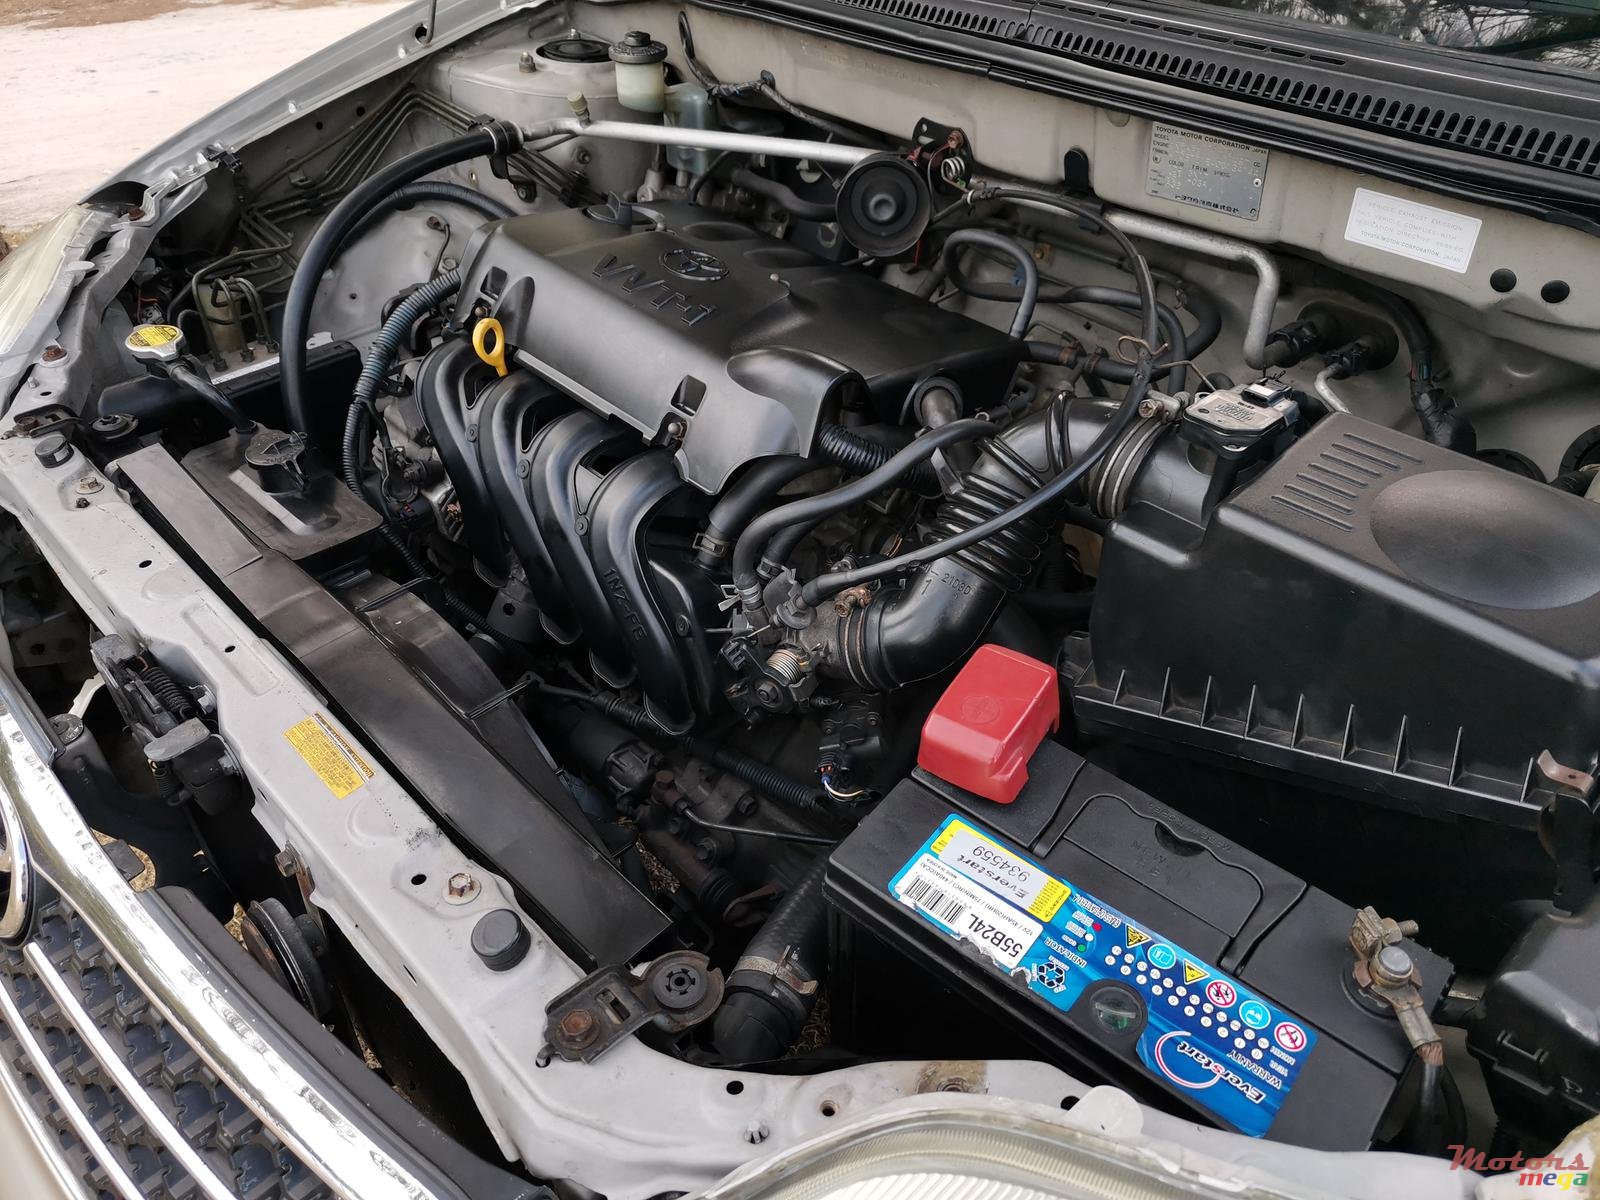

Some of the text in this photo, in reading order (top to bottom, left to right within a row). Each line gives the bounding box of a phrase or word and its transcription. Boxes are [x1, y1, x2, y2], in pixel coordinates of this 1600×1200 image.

[1155, 125, 1178, 134] TOYOTA
[1180, 131, 1202, 140] MOTOR
[1204, 136, 1249, 151] CORPORATION
[1168, 159, 1184, 167] COLOR
[1360, 230, 1379, 239] TOYOTA
[1380, 236, 1400, 245] MOTOR
[1400, 241, 1439, 256] CORPORATION
[1439, 231, 1456, 240] WITH
[956, 854, 1028, 900] Everstart
[972, 844, 1031, 883] 934559
[967, 912, 1024, 959] 55B24L
[1021, 925, 1033, 936] 12V
[1043, 936, 1087, 968] INDICATOR
[1175, 1040, 1265, 1104] Everstart
[1227, 1049, 1283, 1090] WARRANTY
